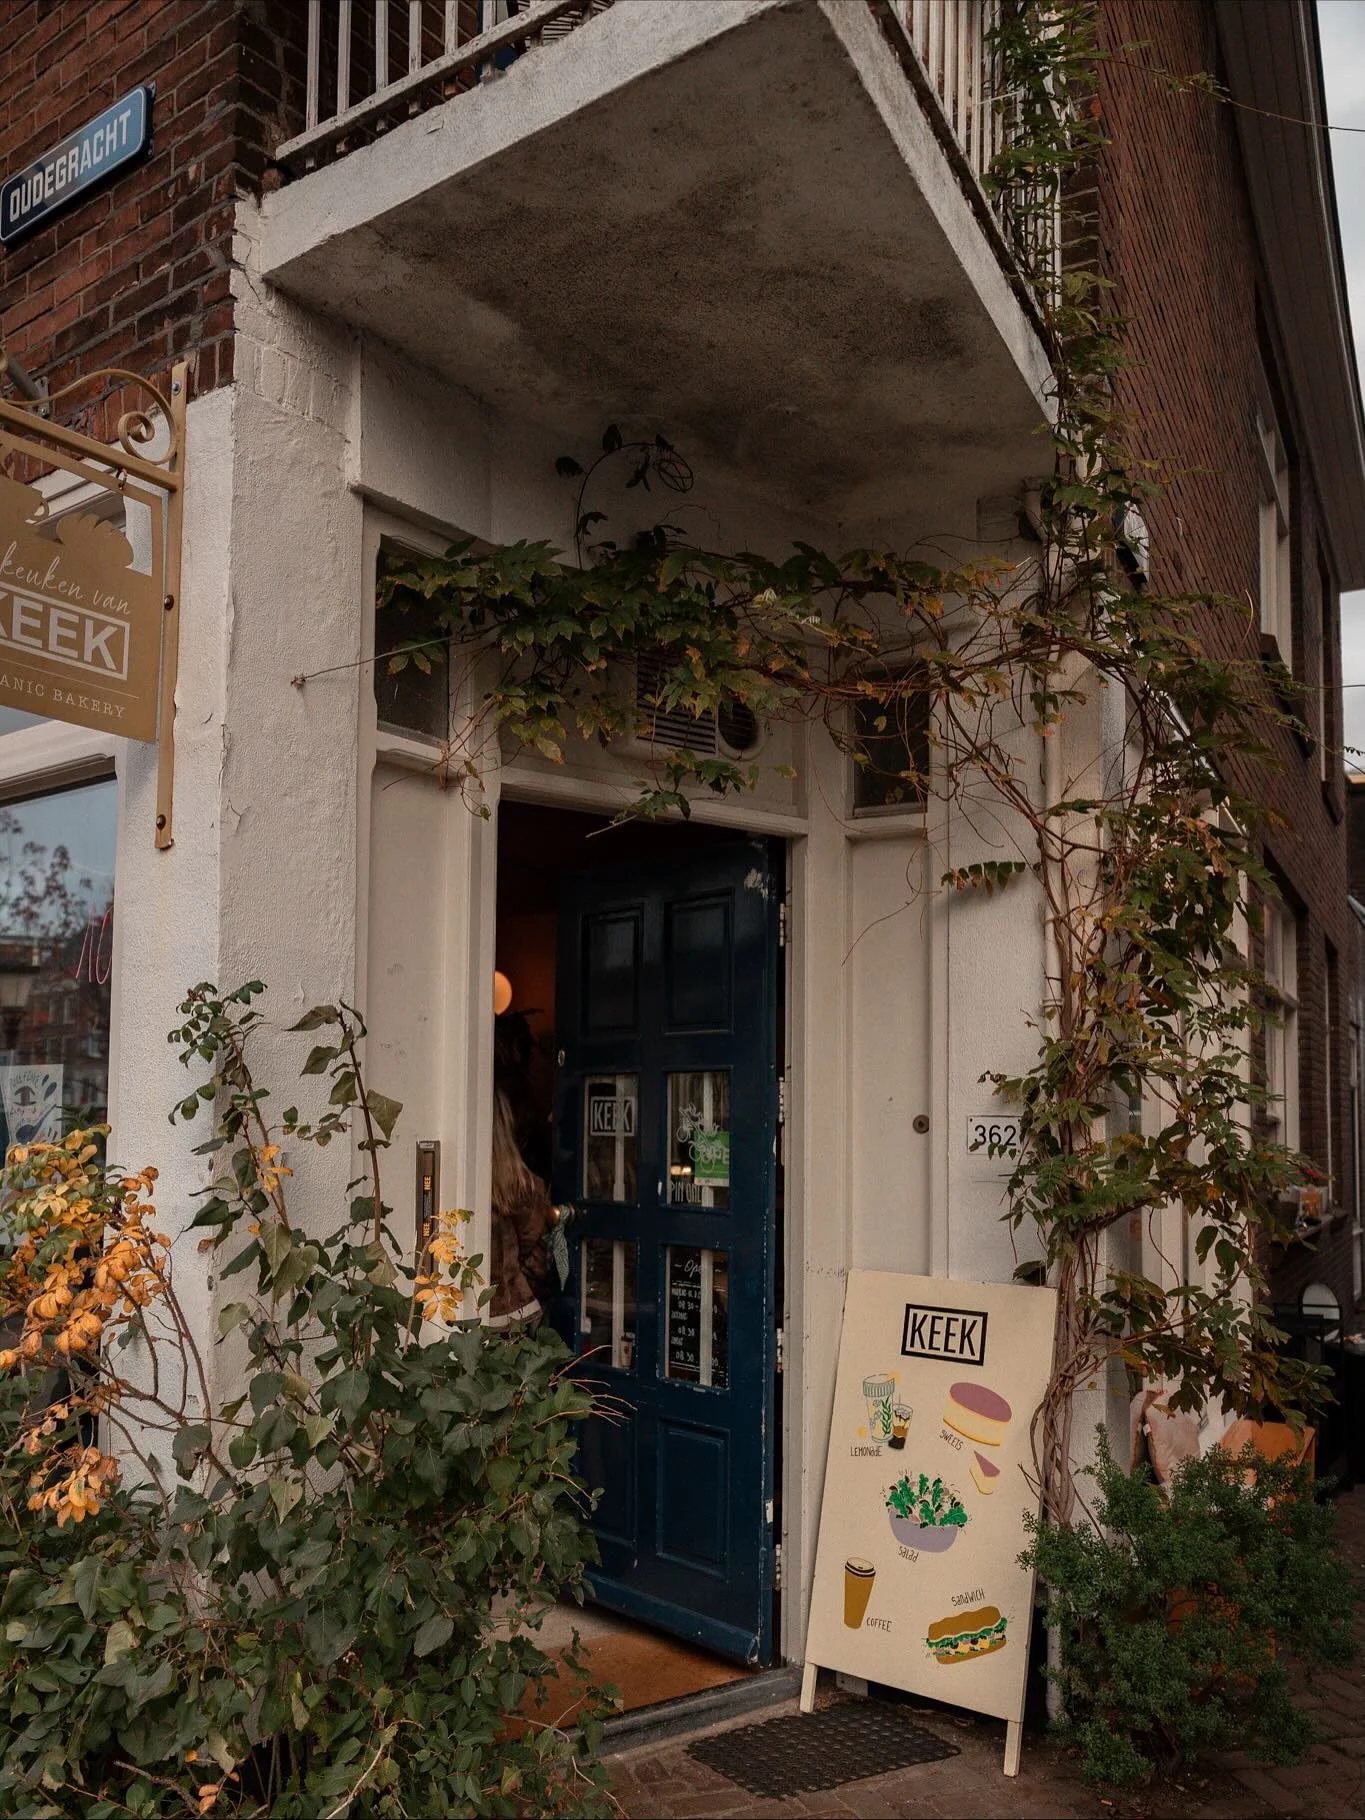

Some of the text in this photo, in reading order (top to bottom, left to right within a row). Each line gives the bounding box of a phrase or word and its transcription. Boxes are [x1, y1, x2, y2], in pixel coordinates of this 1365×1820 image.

[9, 108, 131, 222] OUDEGRACHT
[0, 541, 130, 615] keuken van
[0, 592, 118, 671] EEK
[53, 688, 126, 719] BAKERY
[975, 1125, 1017, 1147] 362
[909, 1313, 977, 1356] KEEK
[939, 1429, 964, 1451] SWEETS
[866, 1616, 892, 1632] COFFEE
